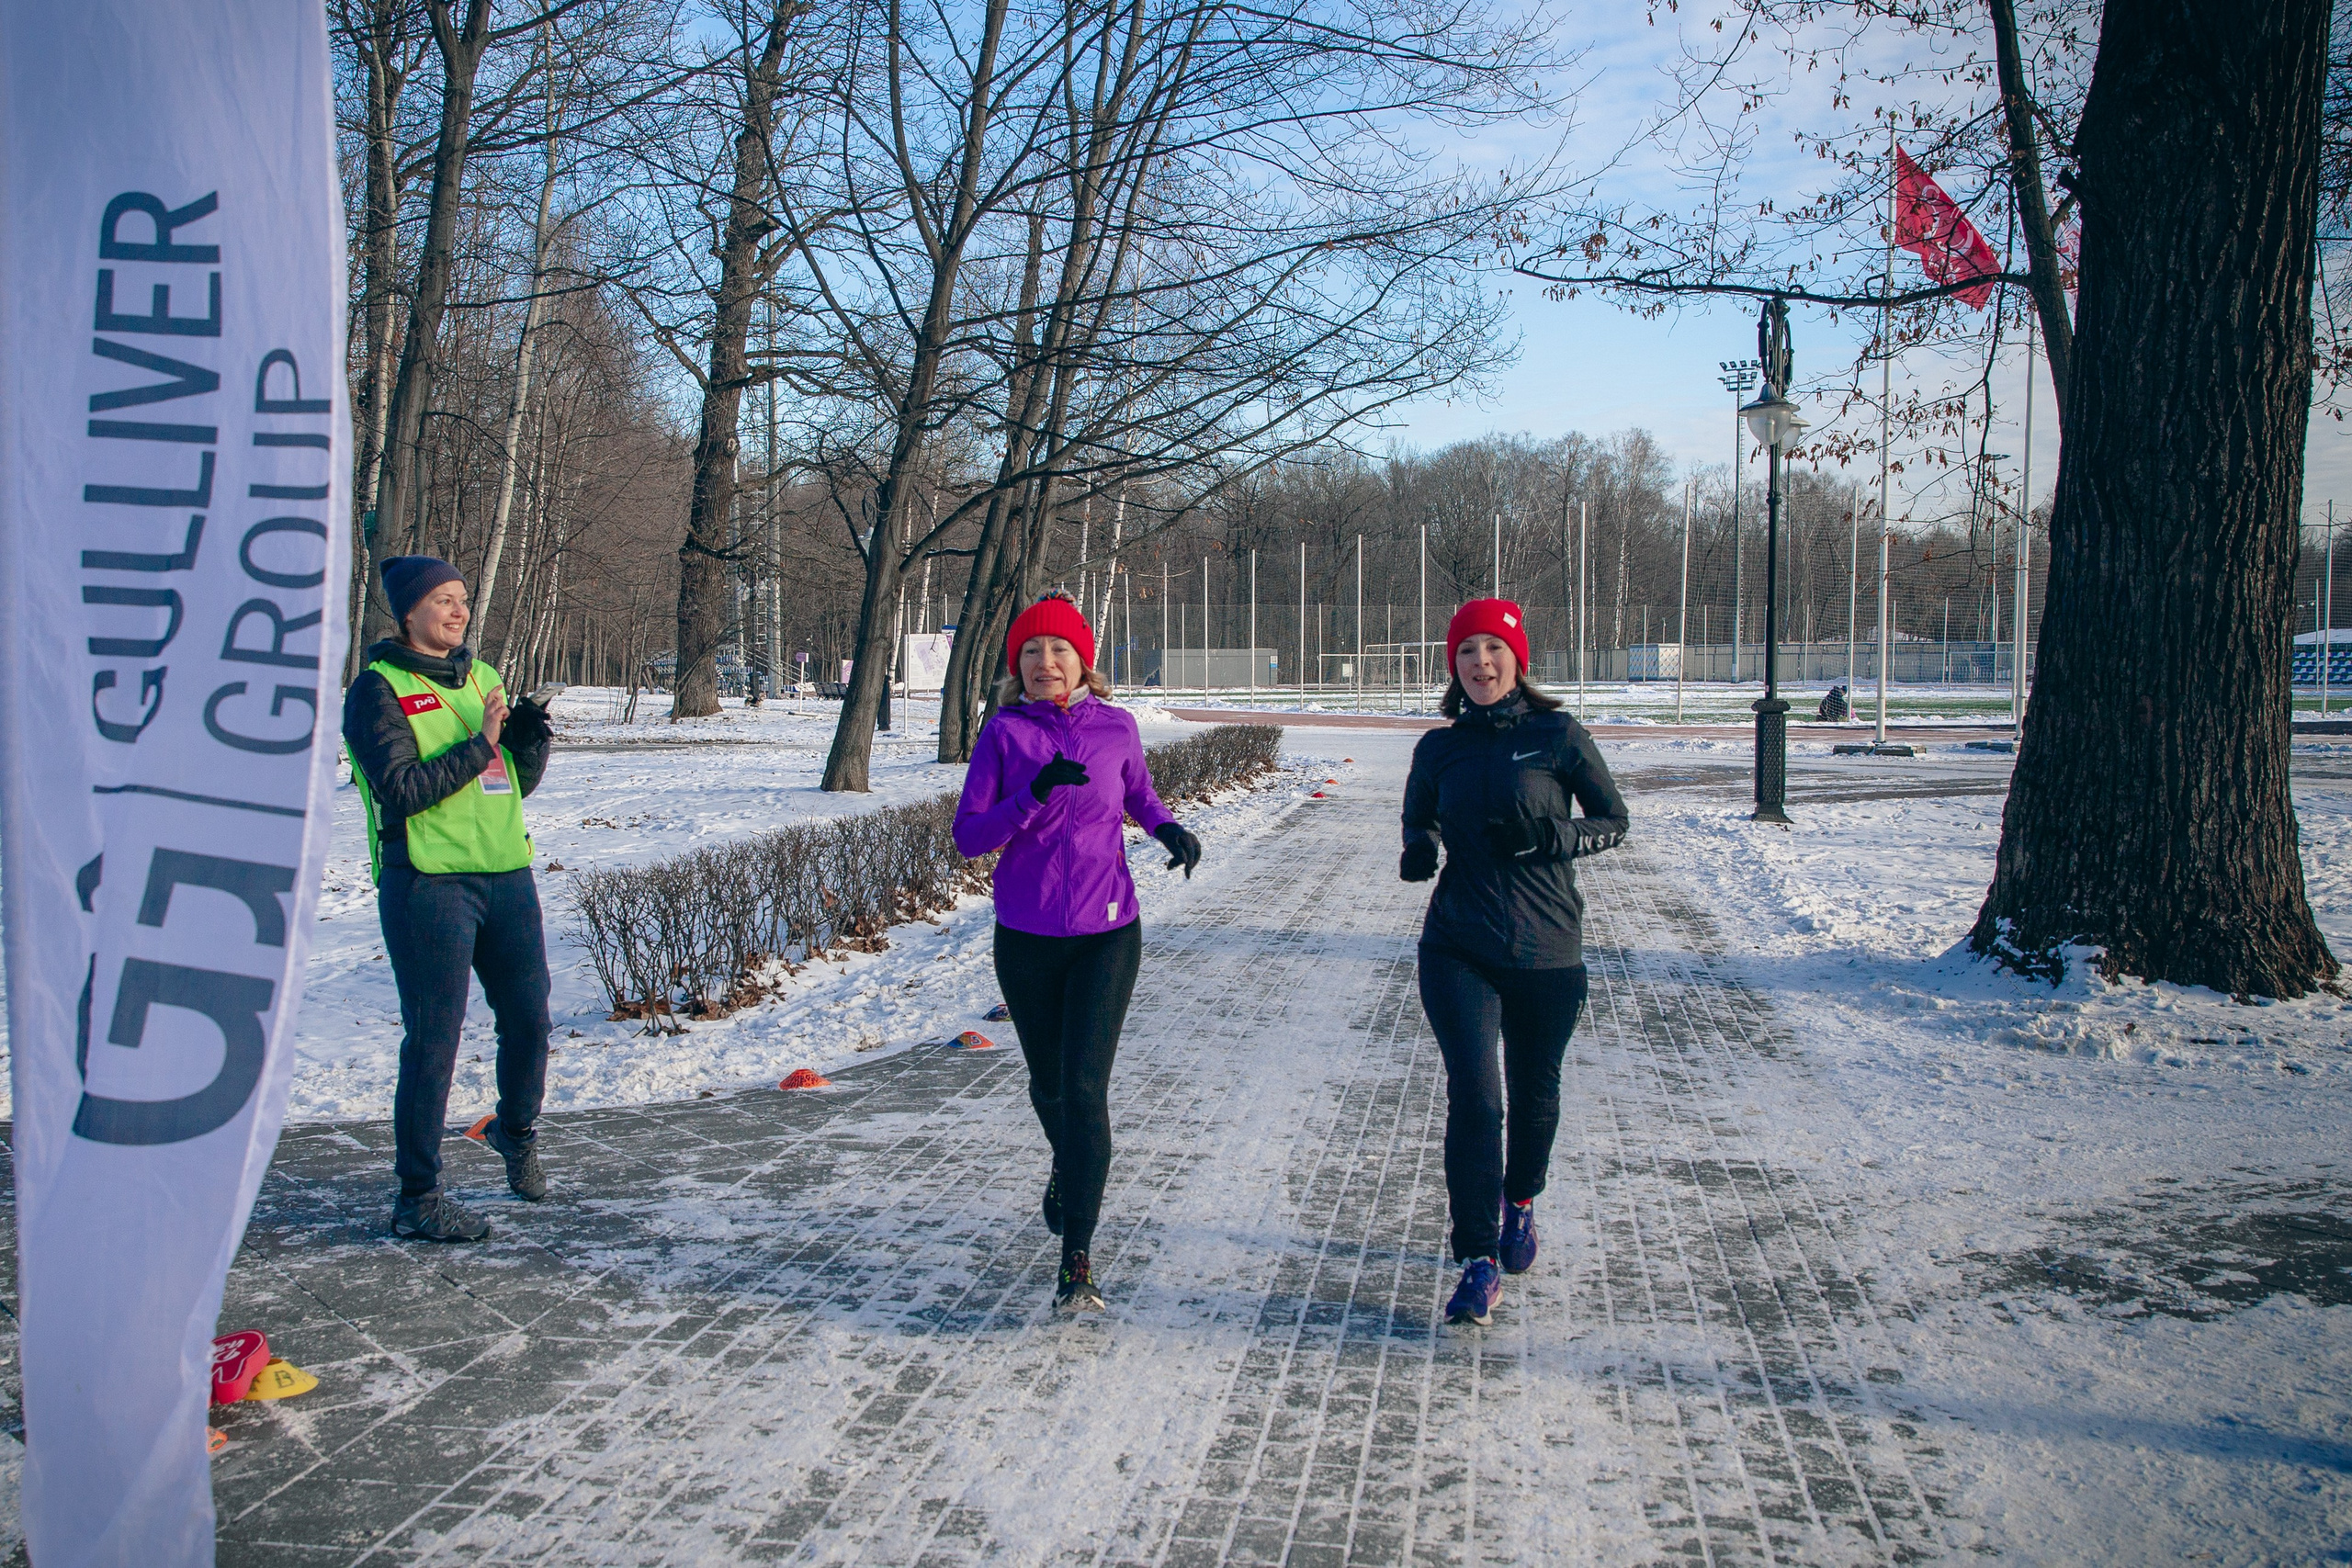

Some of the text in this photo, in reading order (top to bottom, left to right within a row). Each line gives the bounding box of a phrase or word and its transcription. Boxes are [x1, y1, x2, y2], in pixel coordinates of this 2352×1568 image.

[81, 190, 221, 744] GULLIVER
[203, 349, 332, 756] GROUP
[1577, 832, 1617, 851] JUST
